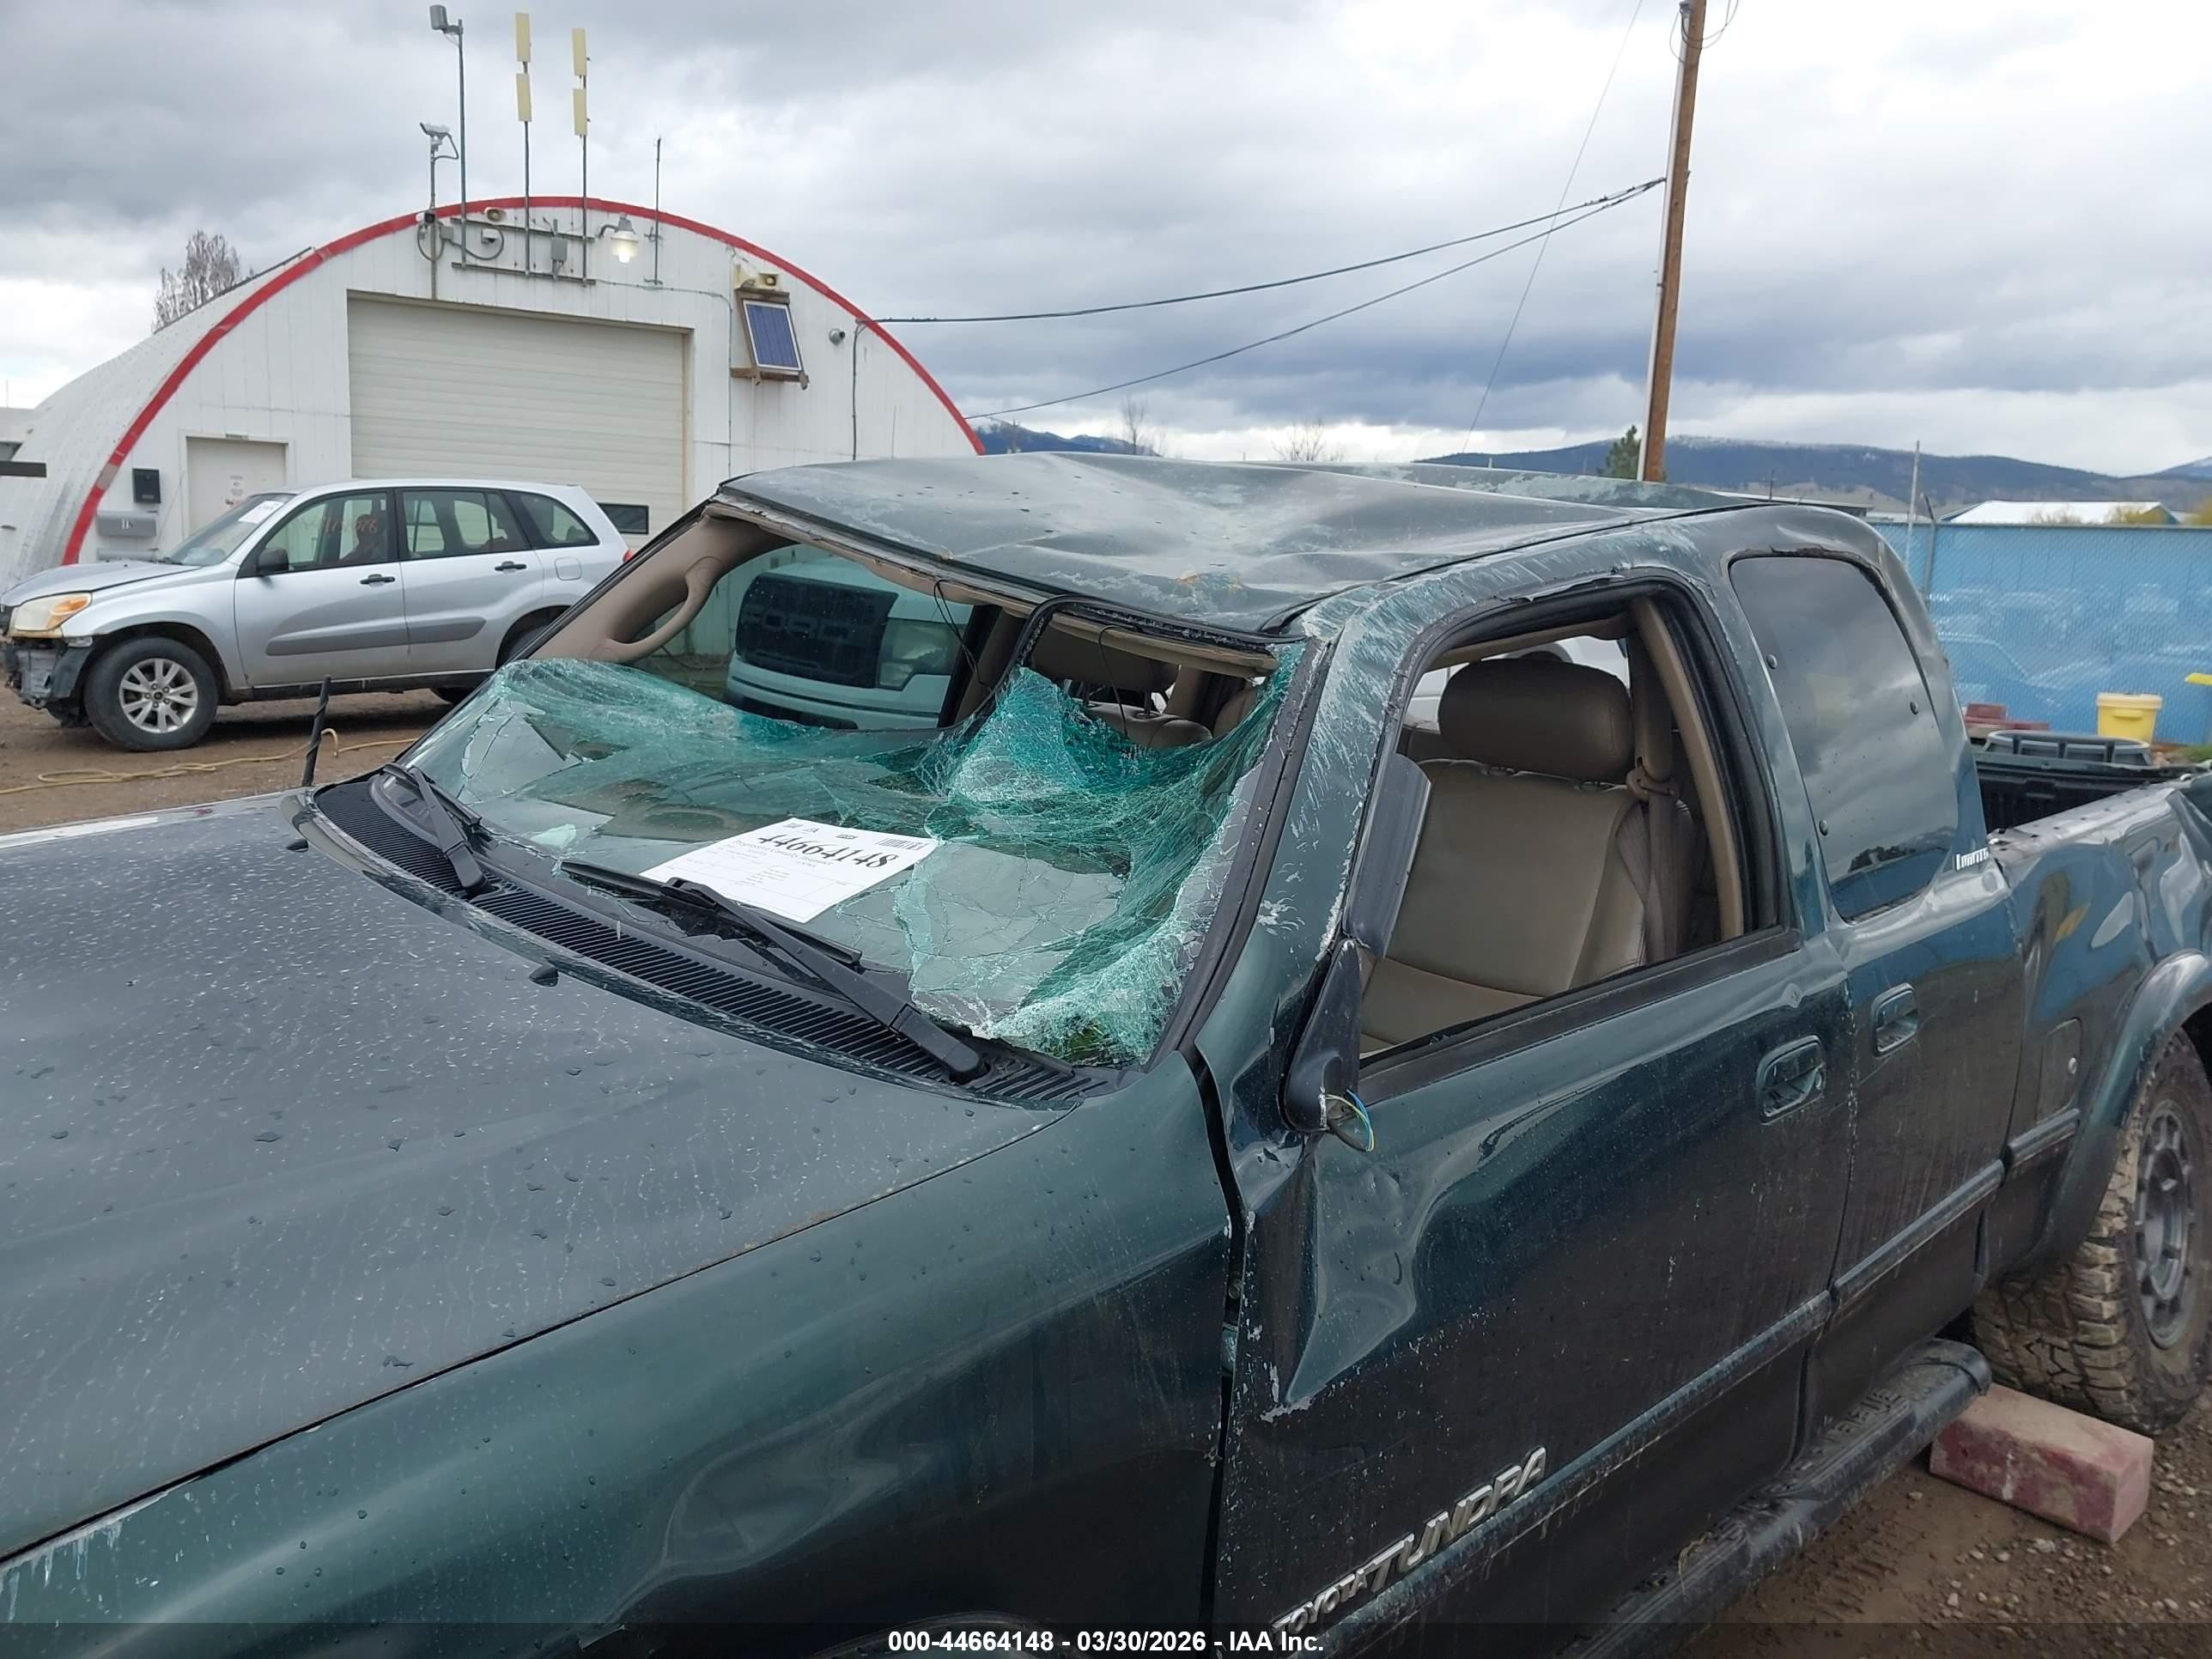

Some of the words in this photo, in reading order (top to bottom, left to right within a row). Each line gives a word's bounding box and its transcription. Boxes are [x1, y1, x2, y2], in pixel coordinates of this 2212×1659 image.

[741, 604, 853, 643] FORD
[757, 834, 900, 868] 44664148
[1271, 1567, 1367, 1646] TOYOTA
[1363, 1446, 1547, 1595] TUNDRA
